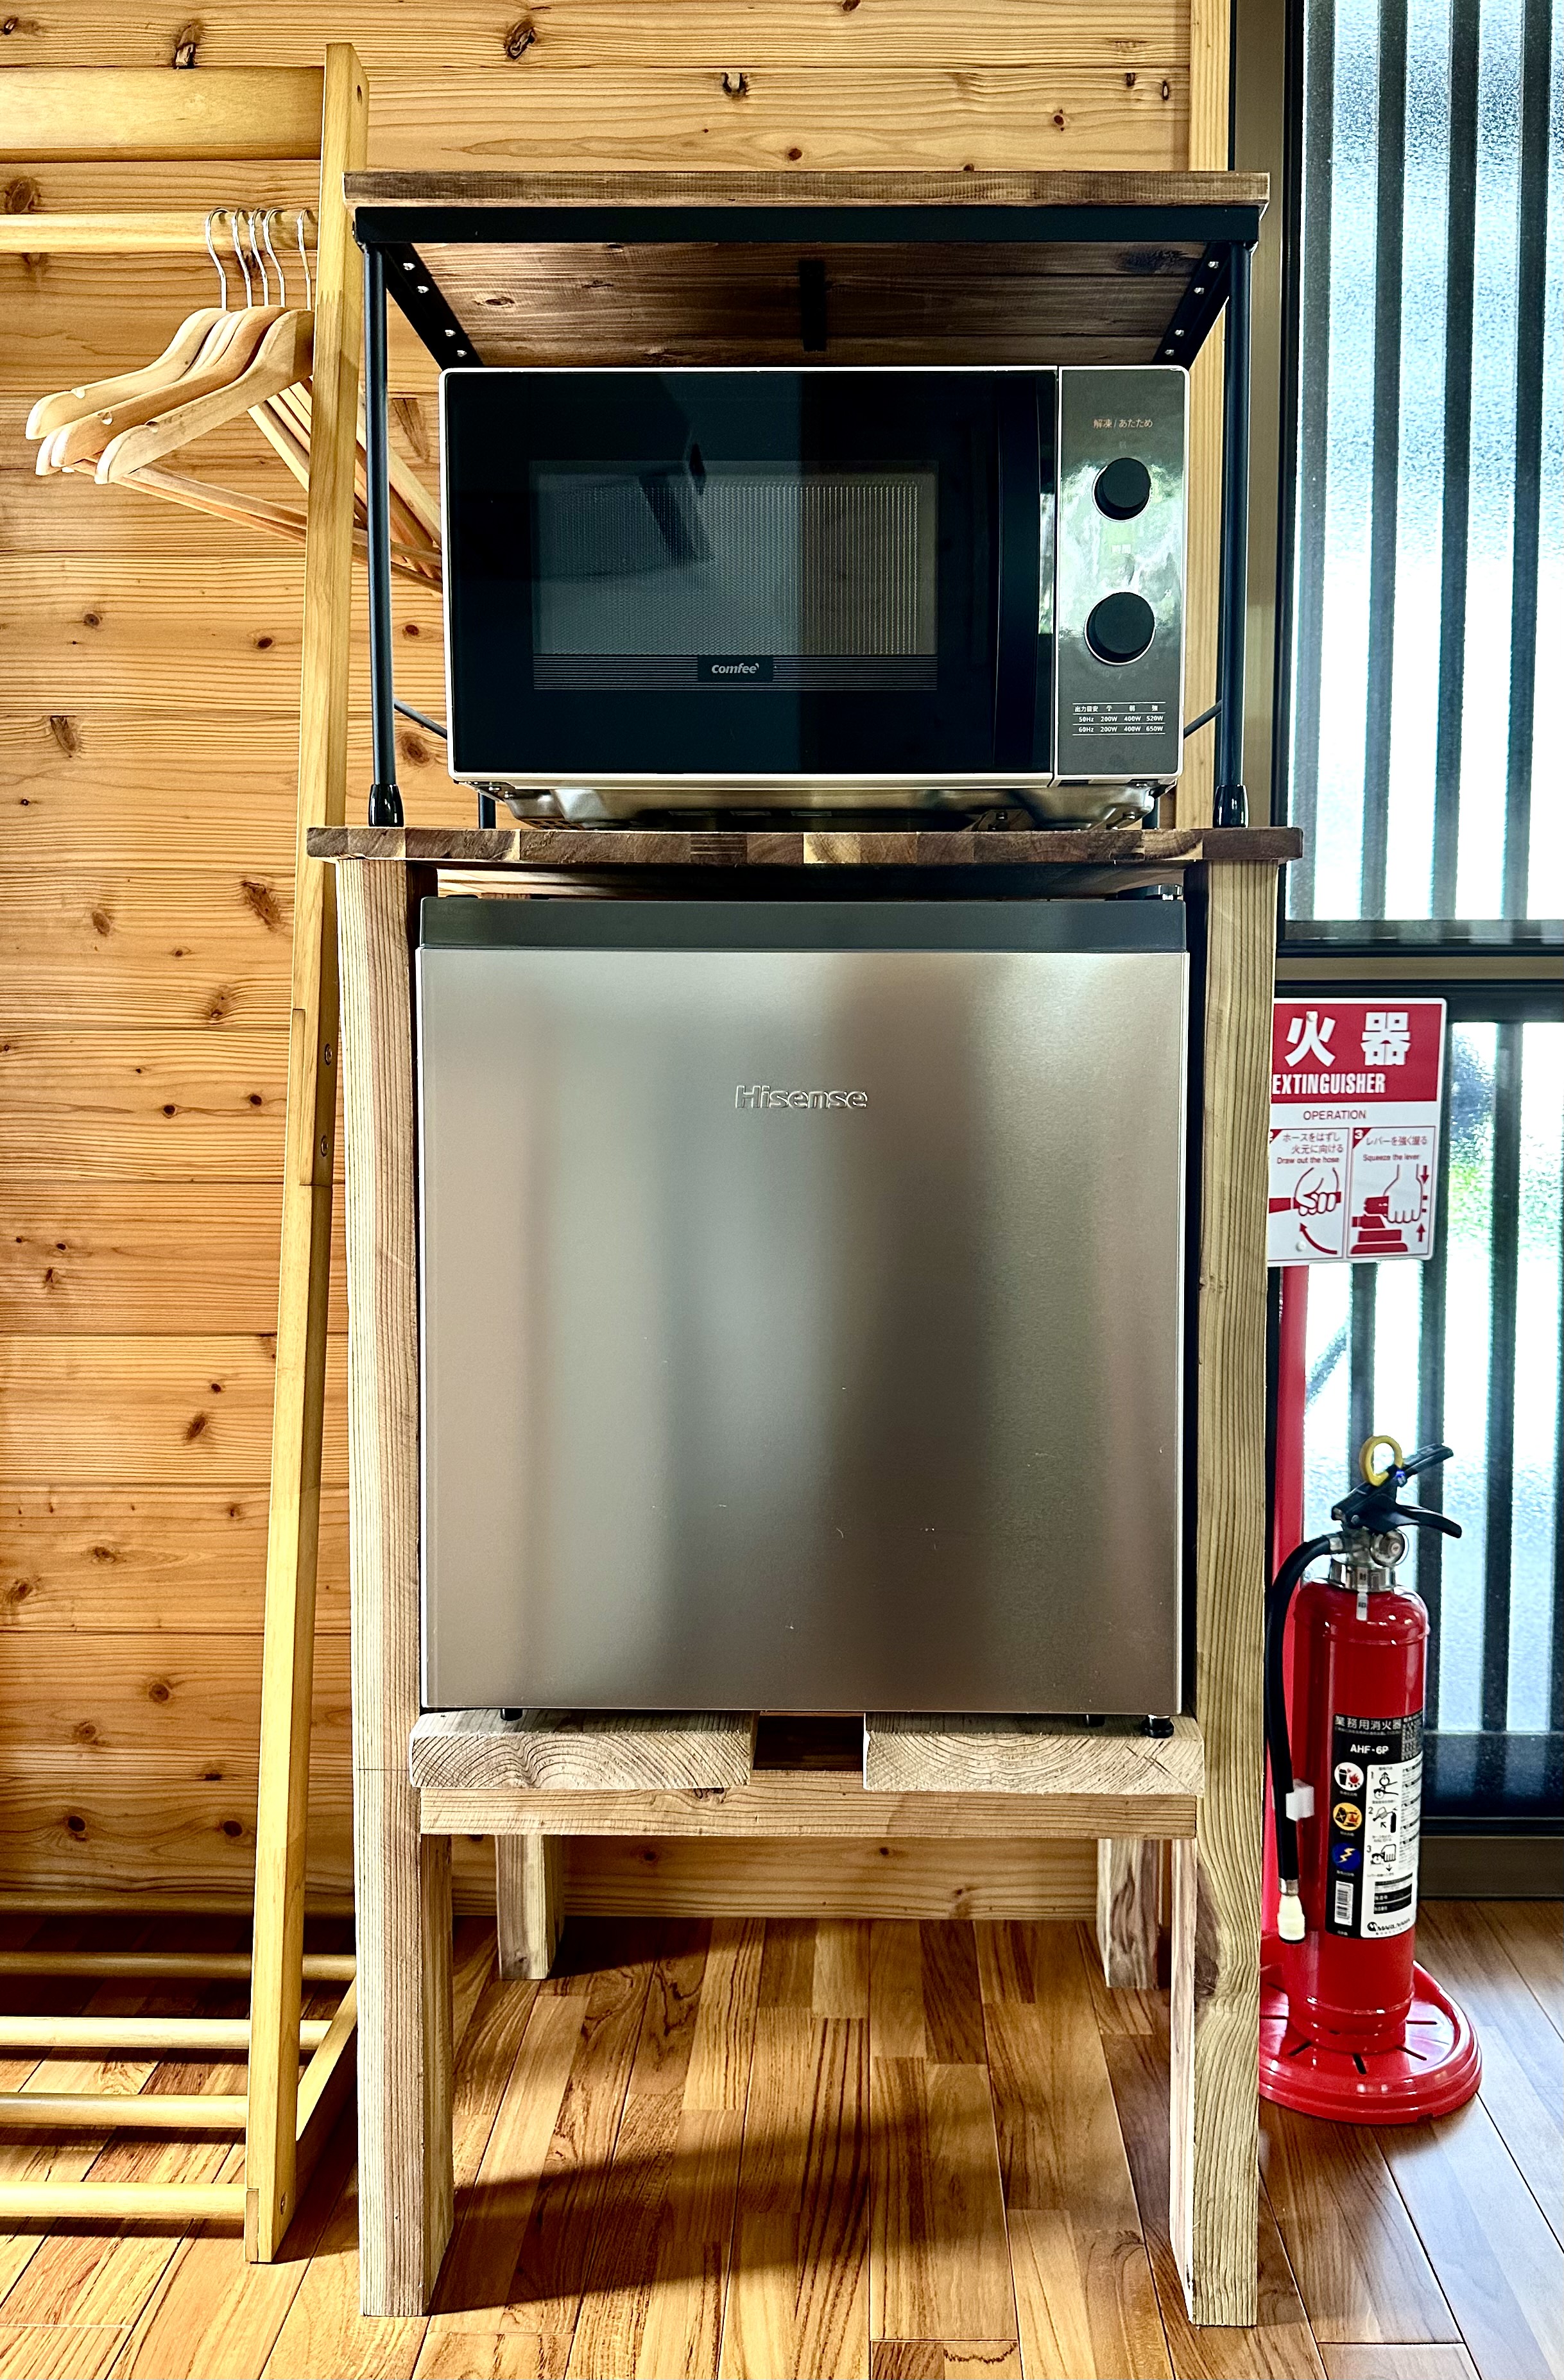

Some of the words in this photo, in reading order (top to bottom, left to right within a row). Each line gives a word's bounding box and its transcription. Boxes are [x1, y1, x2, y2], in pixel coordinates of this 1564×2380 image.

[1272, 1073, 1386, 1095] EXTINGUISHER
[735, 1085, 868, 1109] Hisense
[1303, 1110, 1366, 1120] OPERATION
[1283, 1132, 1341, 1142] ホースをはずし
[1354, 1129, 1363, 1140] 3
[1291, 1144, 1343, 1154] 火元に向ける
[1335, 1715, 1402, 1731] 業務用消火器
[1350, 1744, 1389, 1755] AHF-6P
